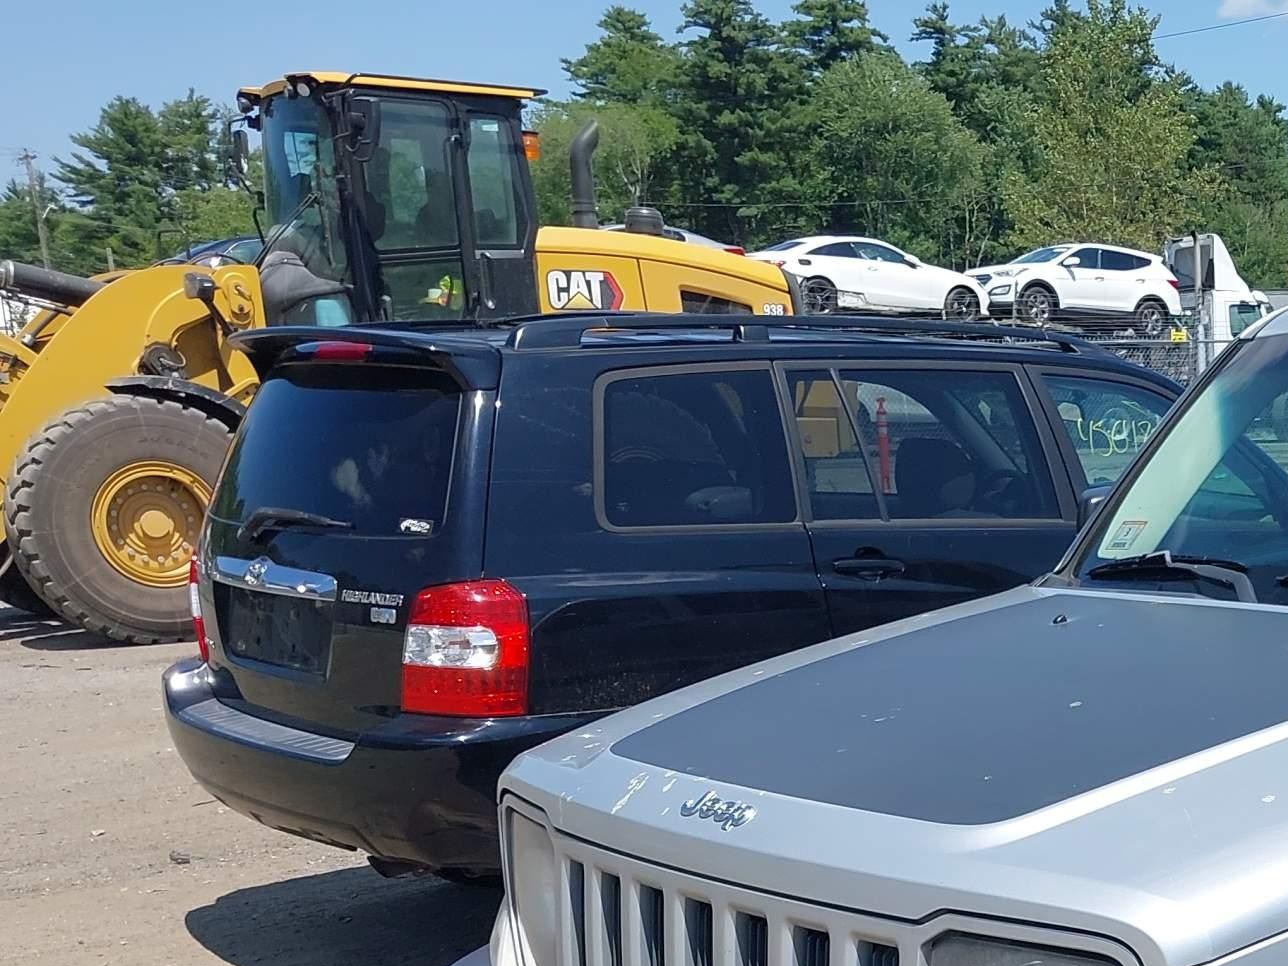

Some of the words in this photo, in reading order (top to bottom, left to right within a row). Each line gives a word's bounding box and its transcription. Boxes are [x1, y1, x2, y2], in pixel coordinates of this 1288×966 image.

[547, 270, 605, 309] CAT
[763, 304, 784, 316] 938
[341, 588, 405, 607] HIGHLANDER
[680, 791, 757, 832] Jeep
